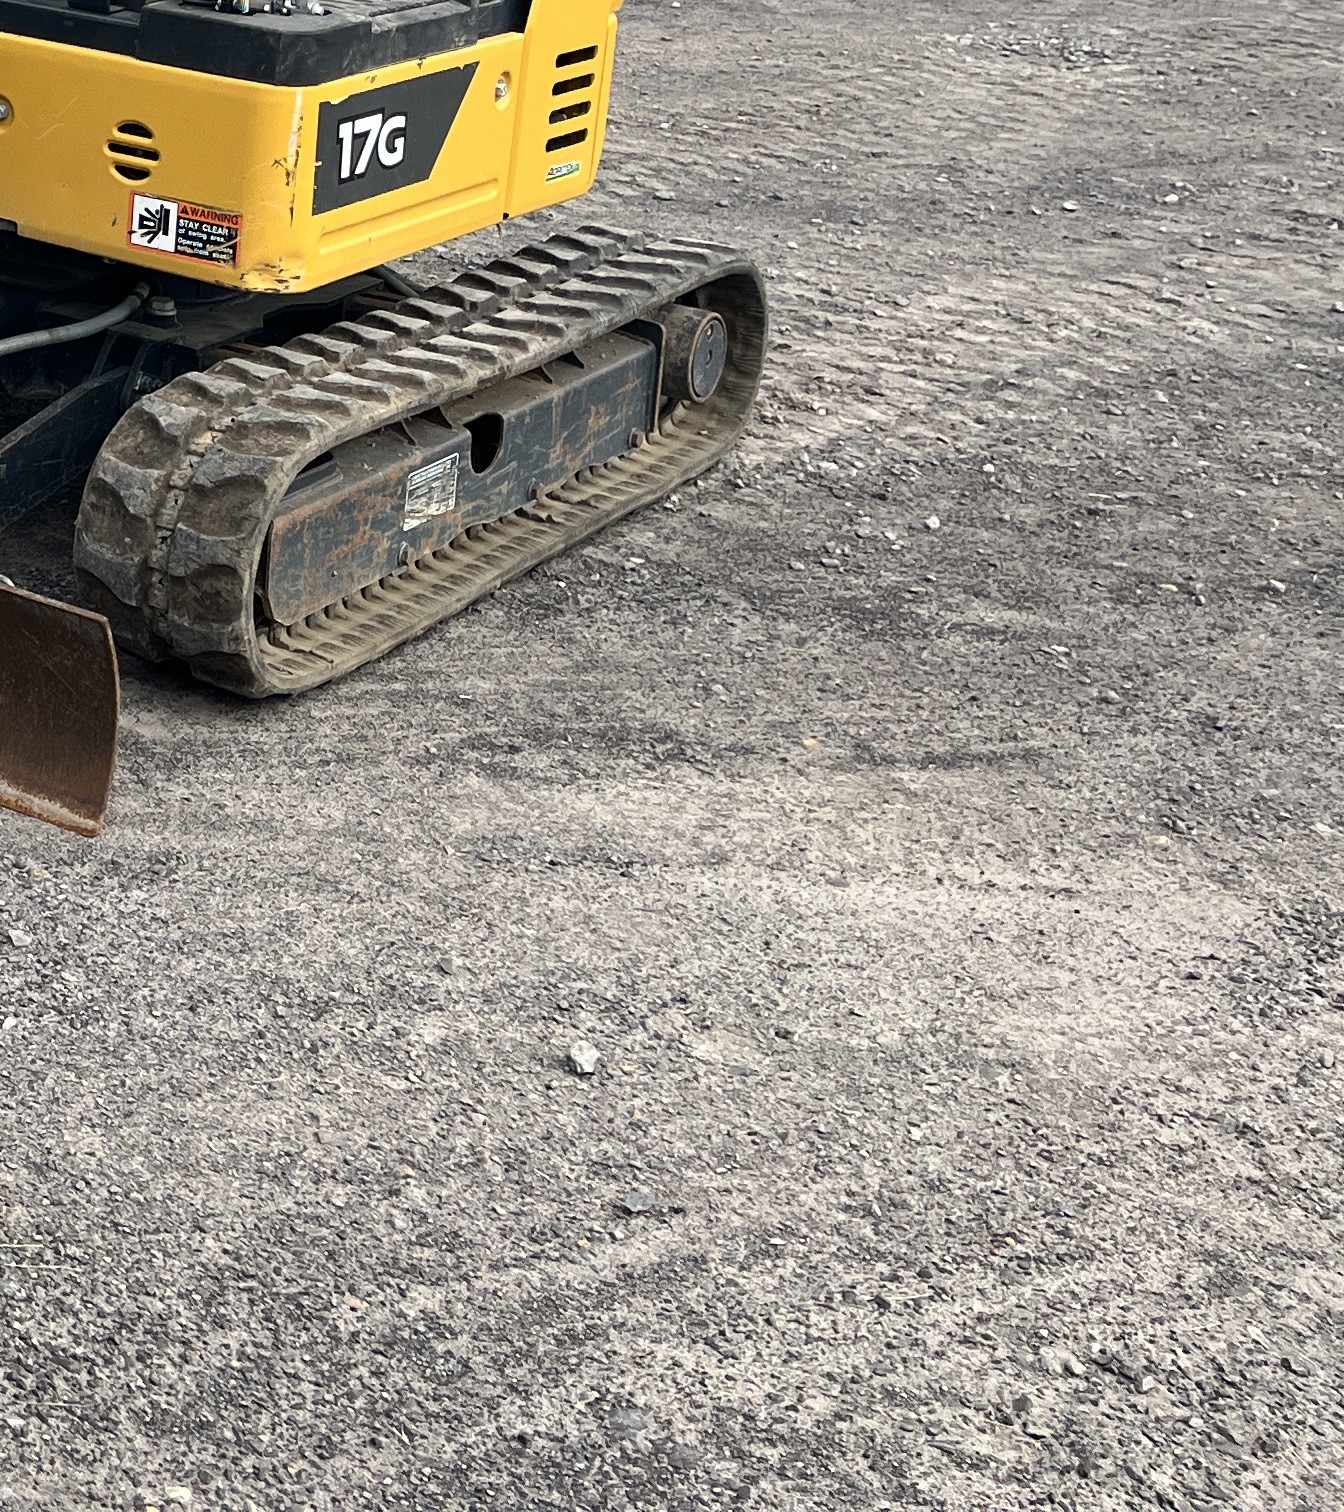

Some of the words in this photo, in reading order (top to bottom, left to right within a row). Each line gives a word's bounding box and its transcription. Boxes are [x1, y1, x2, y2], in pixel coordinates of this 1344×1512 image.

[337, 111, 407, 181] 17G
[190, 206, 239, 226] WARNING
[178, 219, 199, 230] STAY
[202, 223, 229, 236] CLEAR
[177, 237, 203, 248] Operate
